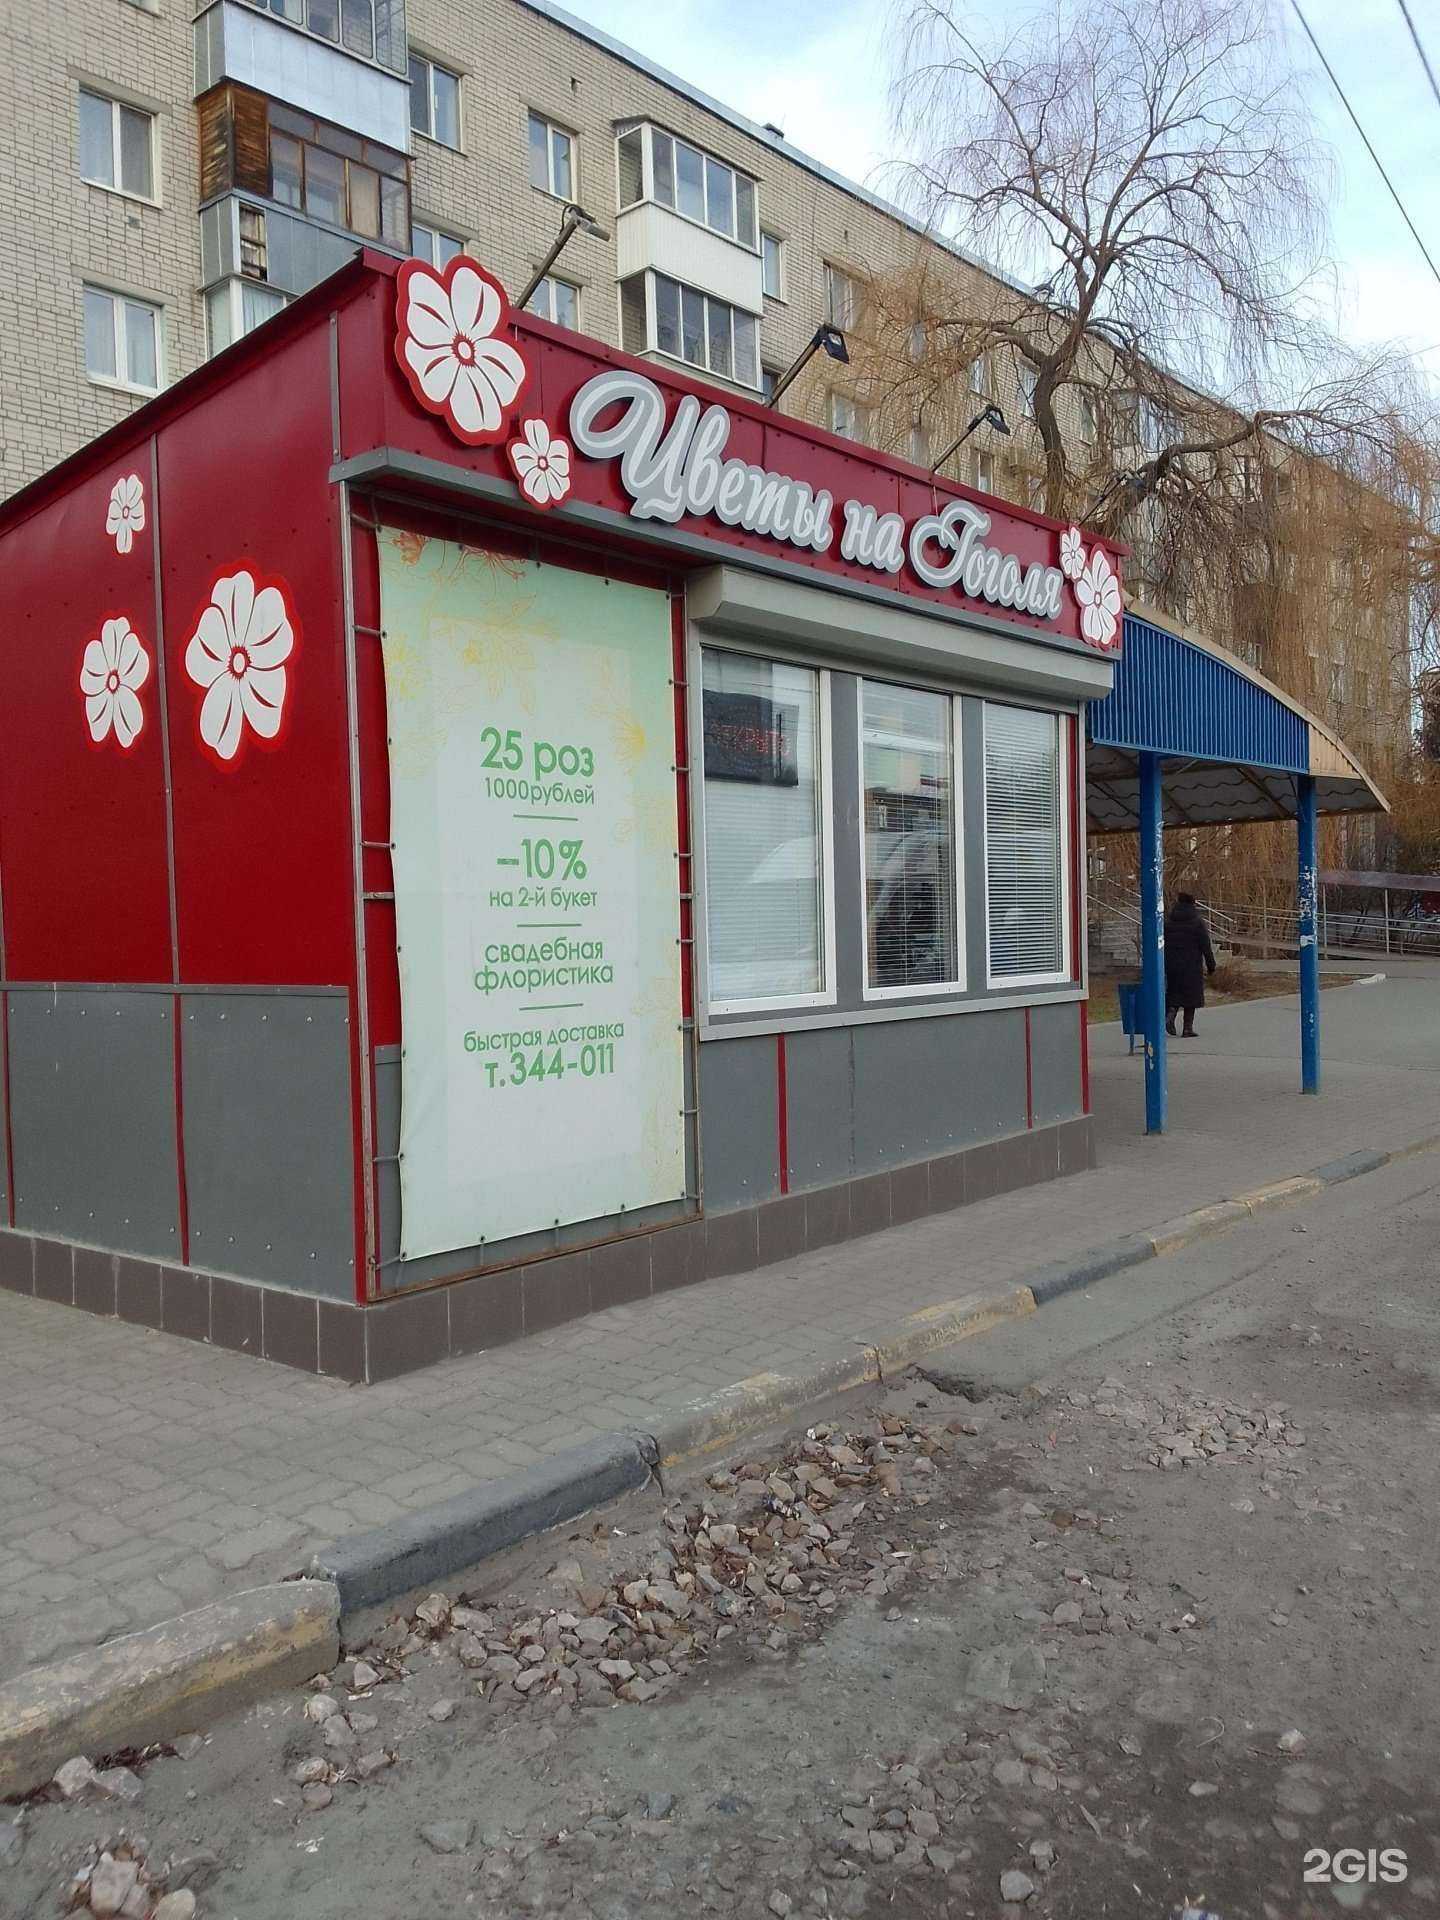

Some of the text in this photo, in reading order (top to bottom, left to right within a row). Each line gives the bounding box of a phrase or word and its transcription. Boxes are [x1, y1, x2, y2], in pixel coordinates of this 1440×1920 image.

[571, 371, 1062, 619] Цветы на Гоголя
[480, 727, 594, 781] 25 роз
[489, 886, 598, 911] на 2-й букет
[484, 936, 604, 964] свадебная
[474, 965, 614, 995] флористика
[463, 1022, 625, 1053] быстрая доставка
